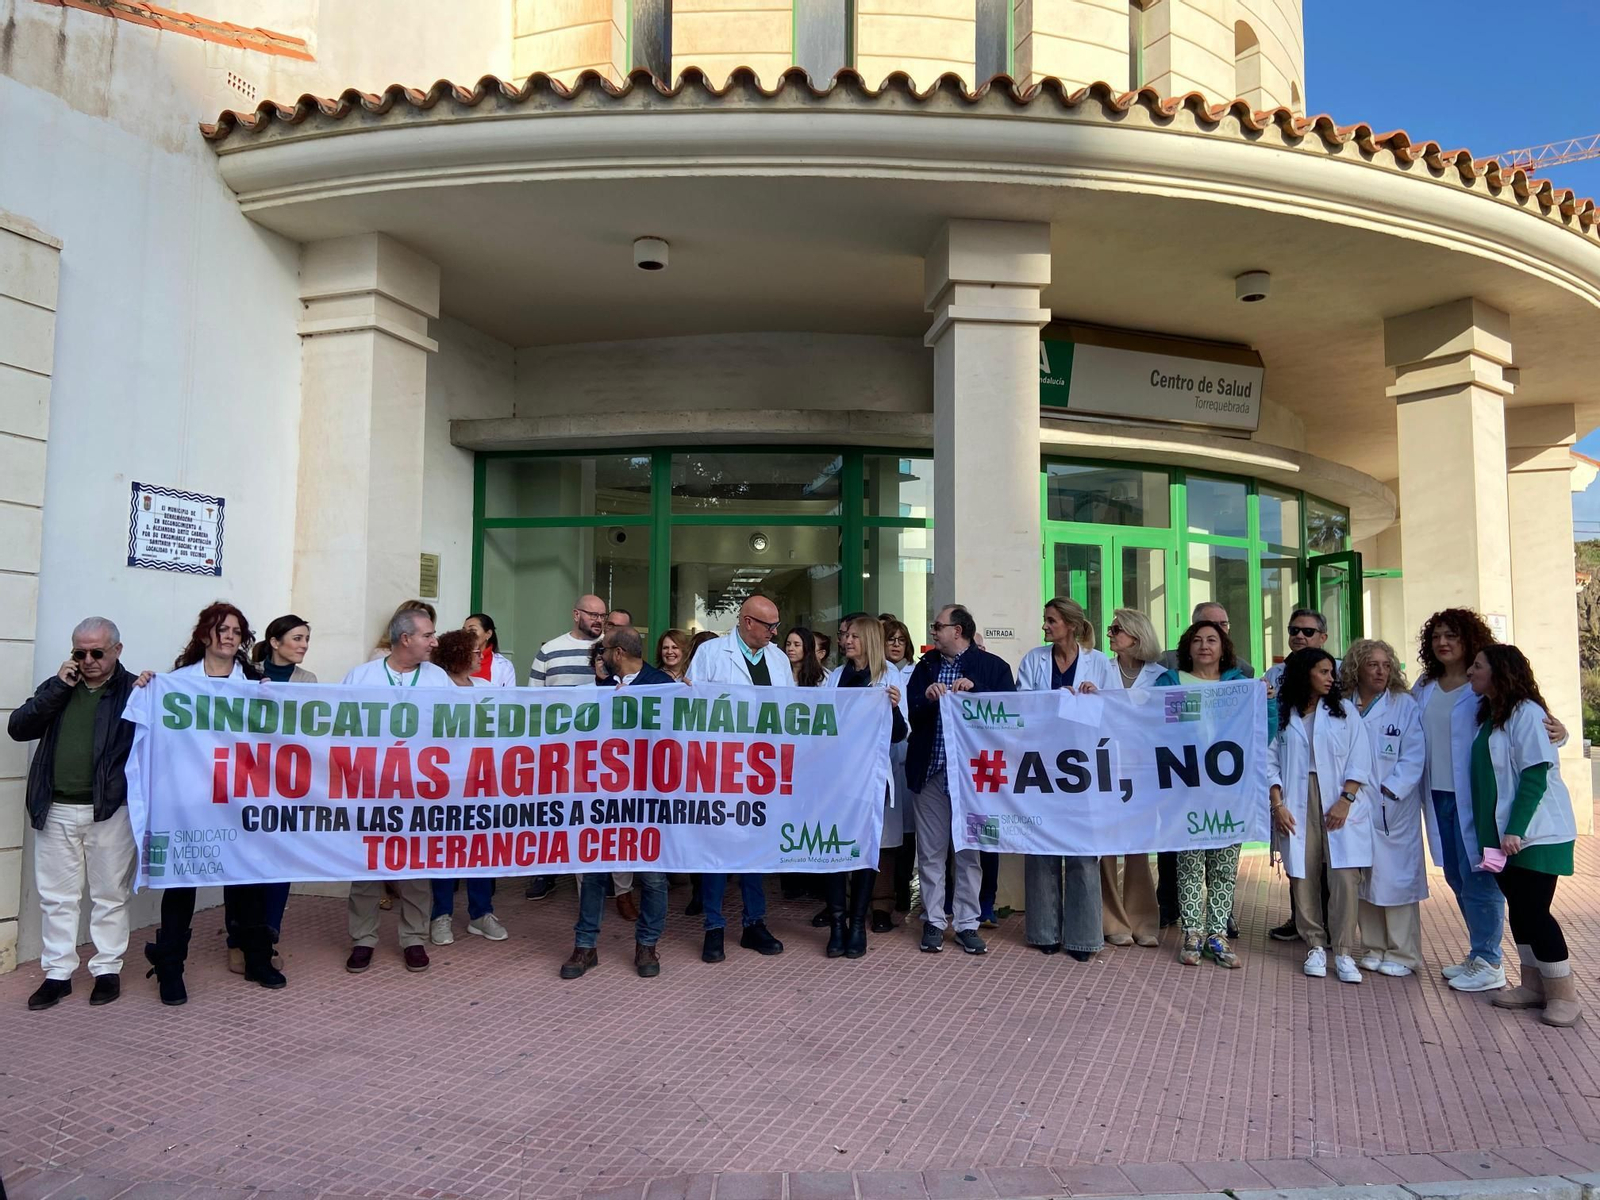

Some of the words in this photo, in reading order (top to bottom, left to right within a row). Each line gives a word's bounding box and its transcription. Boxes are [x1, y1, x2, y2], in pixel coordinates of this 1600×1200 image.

[1040, 377, 1064, 385] ndalucía
[1150, 370, 1193, 391] Centro
[1198, 376, 1213, 393] de
[1217, 378, 1252, 398] Salud
[1195, 396, 1250, 414] Torrequebrada
[168, 506, 188, 515] MUNICIPIO
[153, 525, 175, 533] ALEJANDRO
[163, 519, 196, 530] RECONOCIMIENTO
[1204, 685, 1248, 698] SINDICATO
[162, 692, 418, 738] SINDICATO
[432, 697, 600, 738] MÉDICO
[612, 696, 661, 730] DE
[672, 694, 838, 736] MÁLAGA
[962, 699, 1020, 724] SMA
[212, 743, 311, 804] ¡NO
[328, 741, 450, 800] MÁS
[463, 739, 795, 800] AGRESIONES!
[970, 738, 1133, 803] #ASÍ,
[1155, 741, 1244, 789] NO
[242, 805, 350, 832] CONTRA
[356, 806, 402, 832] LAS
[409, 801, 564, 832] AGRESIONES
[569, 800, 585, 826] A
[590, 798, 766, 826] SANITARIAS-OS
[1001, 814, 1042, 826] SINDICATO
[1187, 809, 1244, 835] SMA
[174, 829, 237, 843] SINDICATO
[780, 821, 856, 856] SMA
[173, 844, 220, 859] MÉDICO
[363, 831, 569, 871] TOLERANCIA
[579, 827, 661, 863] CERO
[174, 861, 224, 875] MÁLAGA
